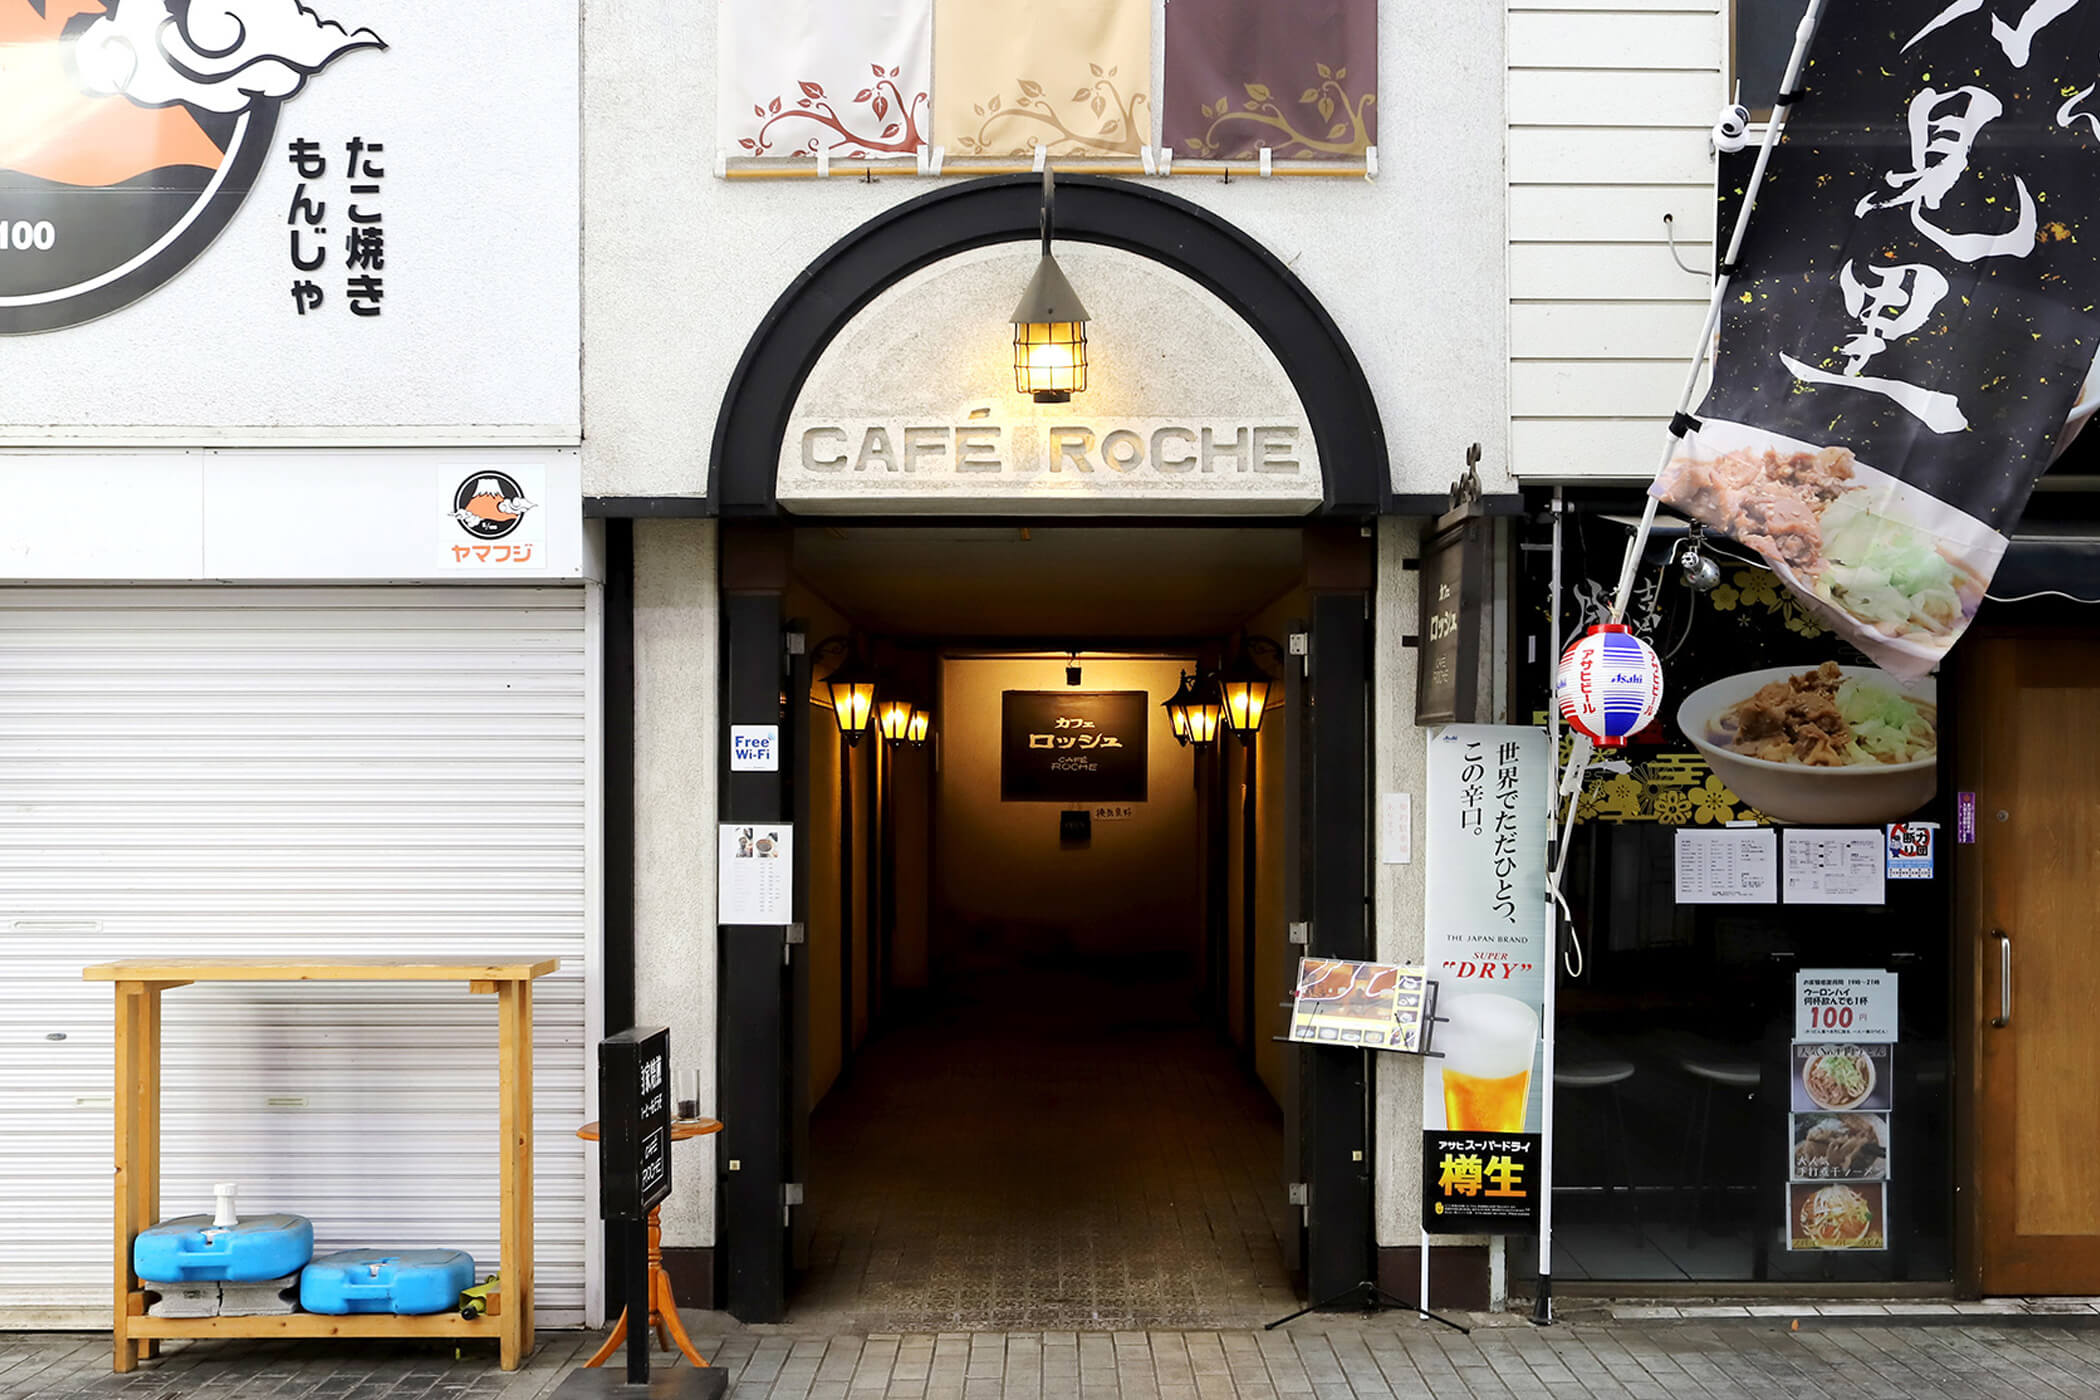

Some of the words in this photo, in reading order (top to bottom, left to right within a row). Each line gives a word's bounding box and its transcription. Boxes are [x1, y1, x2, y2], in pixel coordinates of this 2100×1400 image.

[287, 137, 327, 316] もんじゃ
[346, 136, 385, 317] たこ焼き
[800, 407, 1002, 474] CAFÉ
[1048, 426, 1301, 474] ROCHE
[451, 543, 534, 563] ヤマフジ
[1580, 649, 1596, 715] アサヒビール
[1611, 673, 1643, 684] Asahi
[1054, 716, 1096, 729] カフェ
[735, 735, 770, 748] Free
[1028, 732, 1124, 750] ロッシュ
[735, 748, 770, 760] Wi-Fi
[1051, 762, 1099, 772] ROCHE
[1459, 741, 1485, 837] この辛口。
[1492, 741, 1520, 924] 世界でただひとつ、
[1446, 934, 1463, 943] THE
[1467, 935, 1495, 944] JAPAN
[1497, 935, 1529, 945] BRAND
[1472, 951, 1509, 961] SUPER
[1803, 988, 1850, 997] ウーロンハイ
[1811, 1006, 1853, 1029] 100
[1438, 1139, 1531, 1152] アサヒスーパードライ
[1438, 1153, 1527, 1197] 樽生
